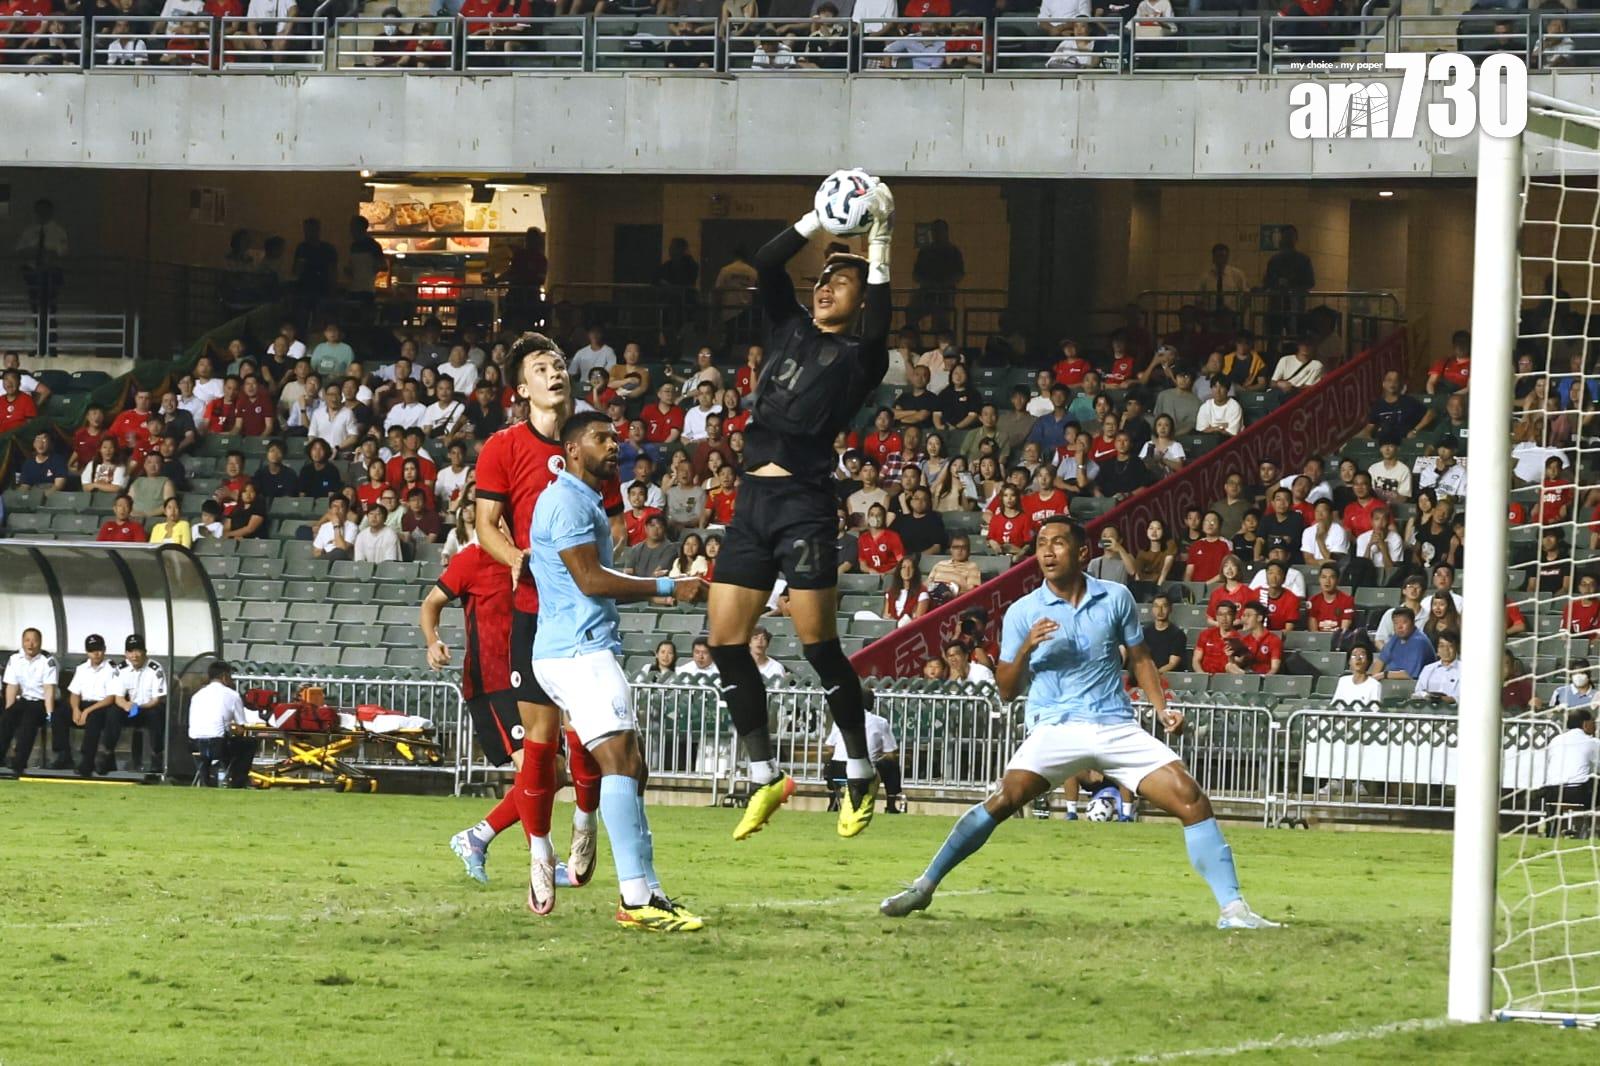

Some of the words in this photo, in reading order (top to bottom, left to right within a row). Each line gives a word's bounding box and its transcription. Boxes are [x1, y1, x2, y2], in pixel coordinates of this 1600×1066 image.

[771, 358, 804, 391] 21
[1288, 344, 1406, 468] STADIU
[791, 539, 821, 574] 21
